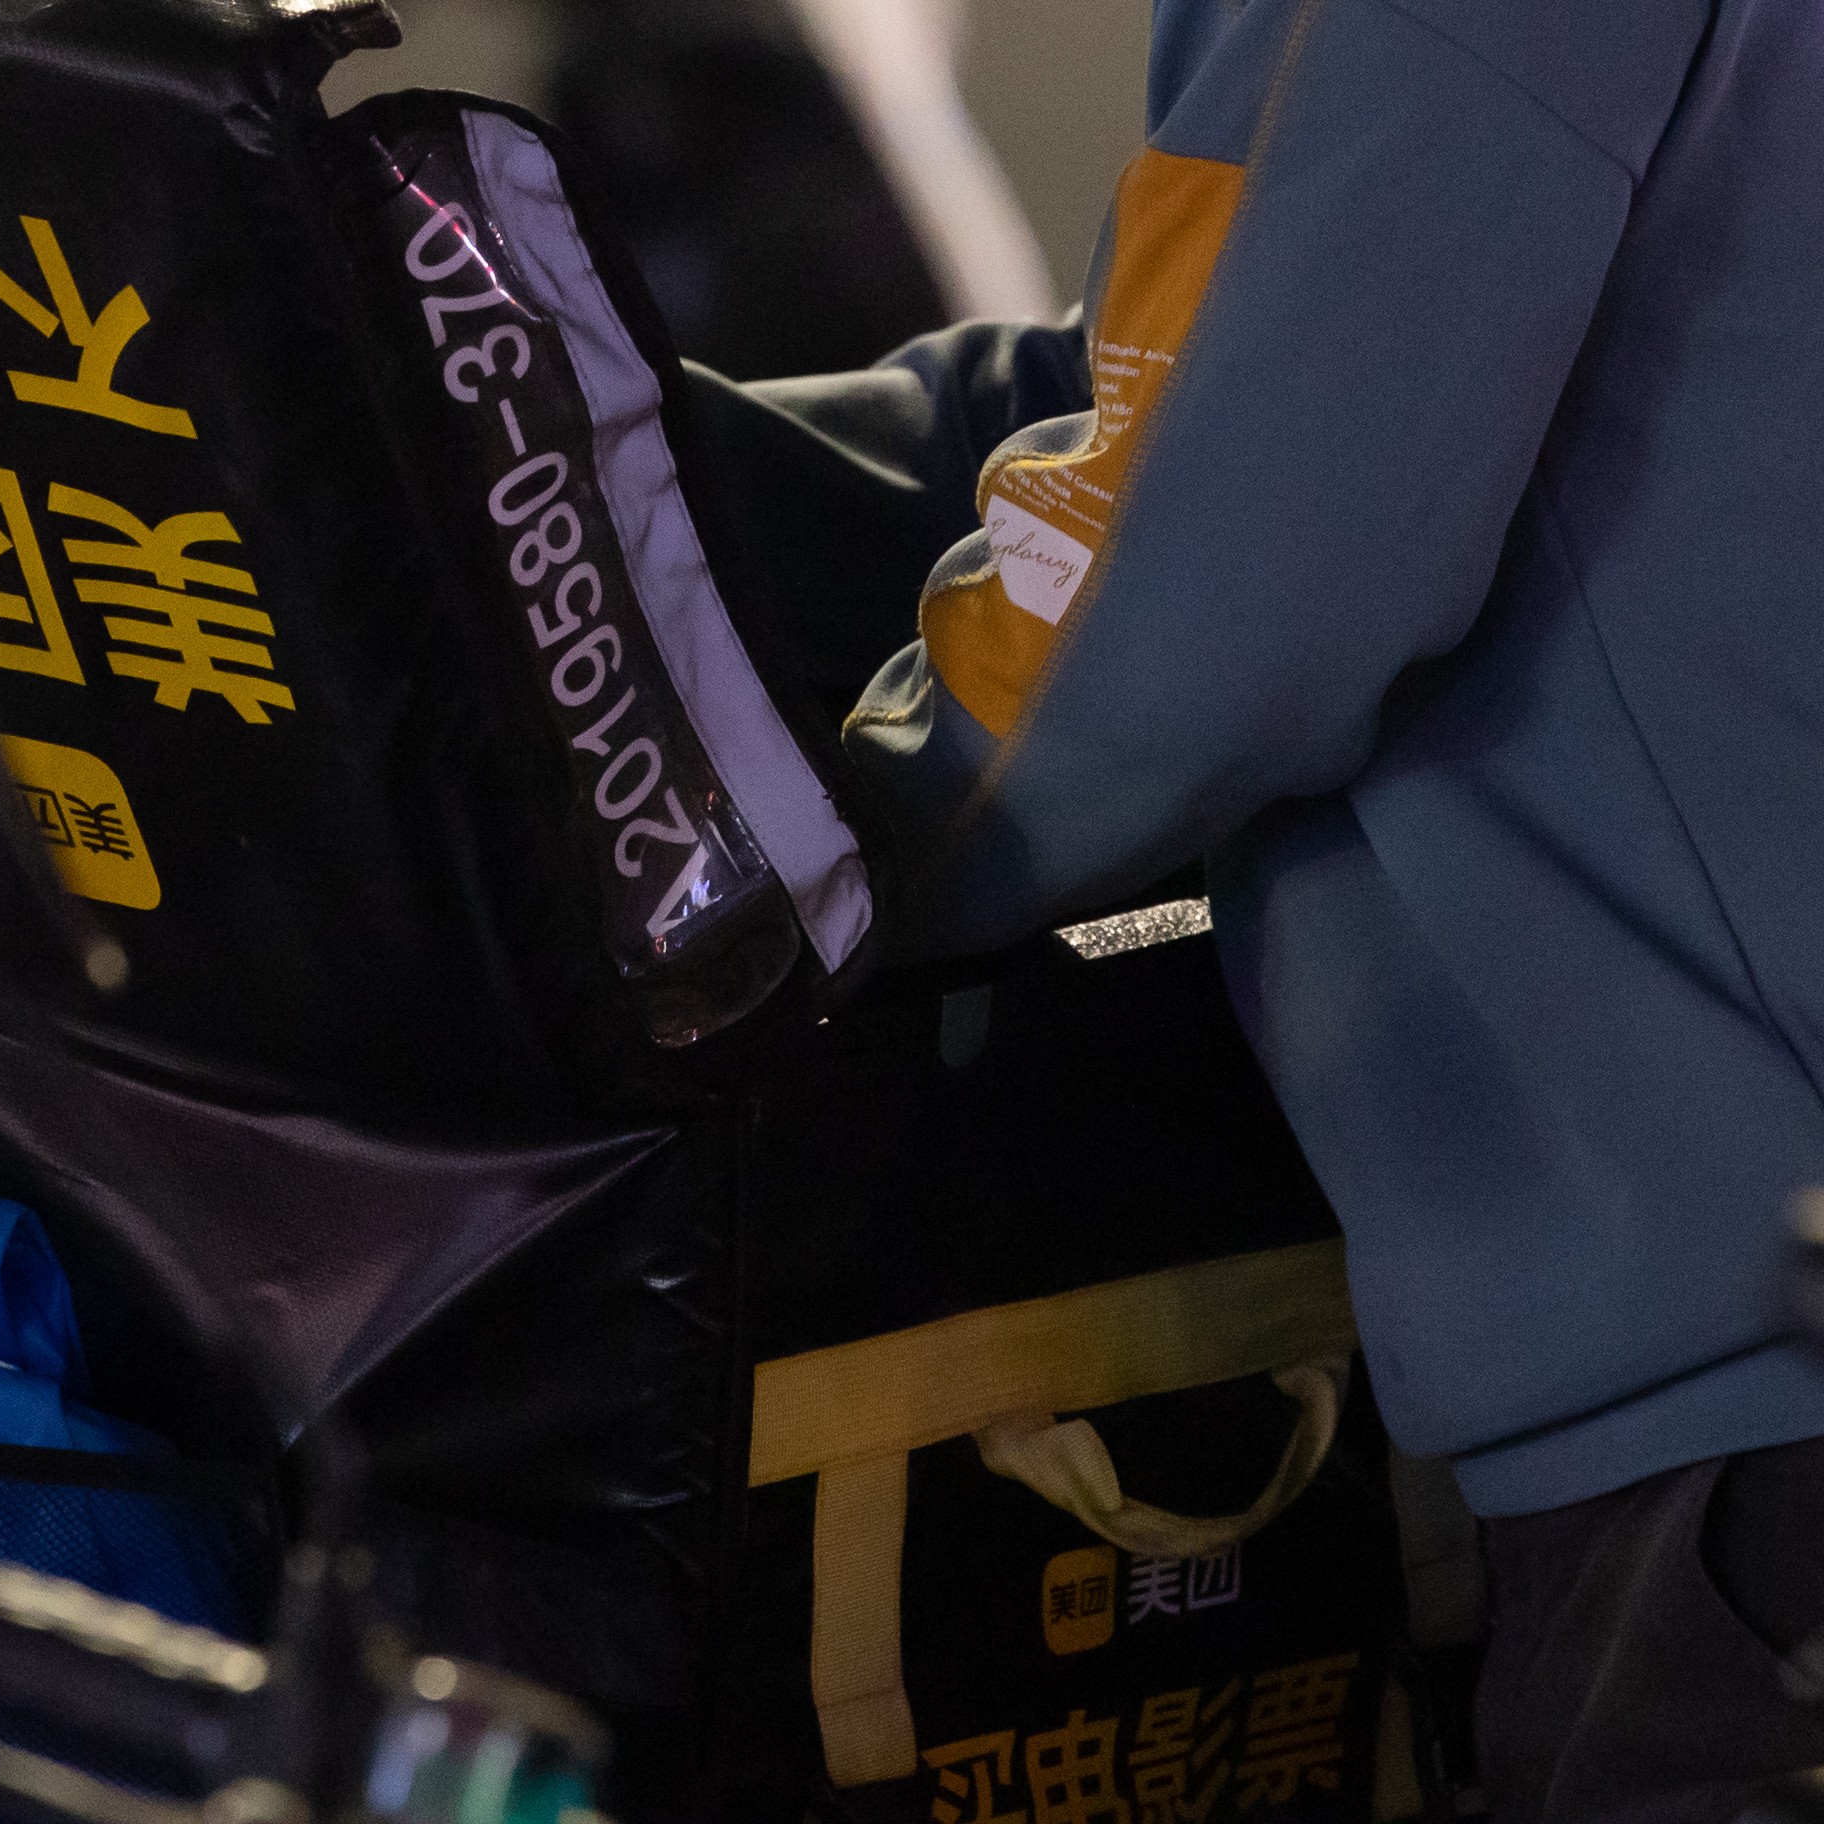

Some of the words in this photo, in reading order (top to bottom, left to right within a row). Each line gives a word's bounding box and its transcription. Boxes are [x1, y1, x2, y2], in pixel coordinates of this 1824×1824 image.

[1049, 1574, 1109, 1623] 美团
[921, 1652, 1360, 1824] 买电影票
